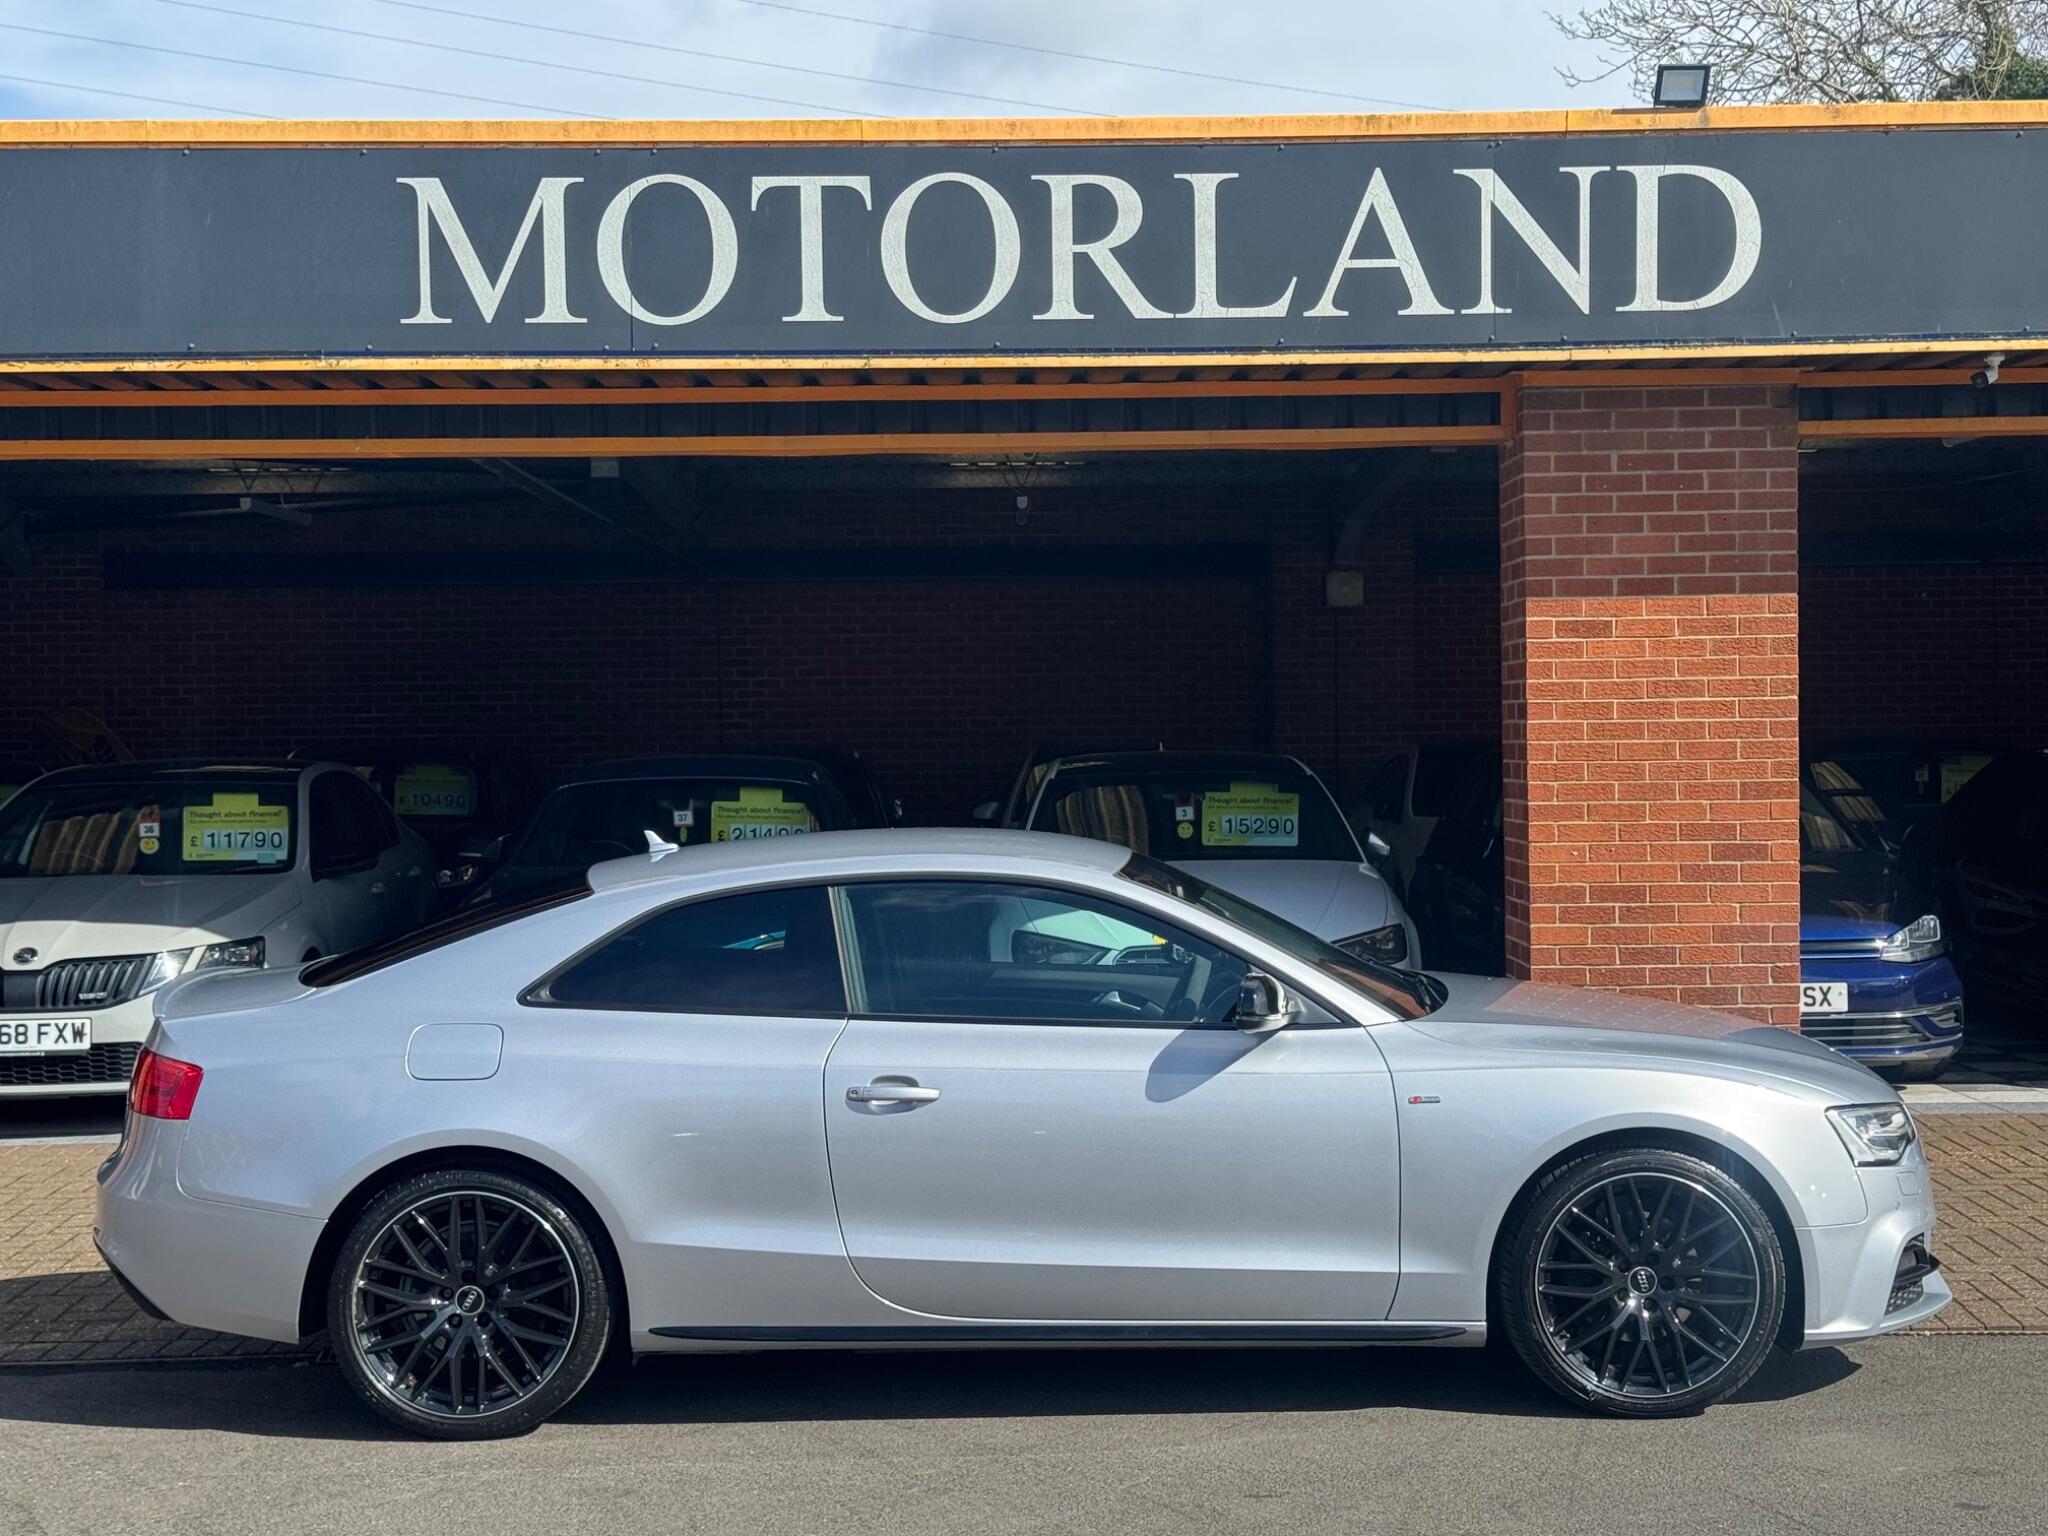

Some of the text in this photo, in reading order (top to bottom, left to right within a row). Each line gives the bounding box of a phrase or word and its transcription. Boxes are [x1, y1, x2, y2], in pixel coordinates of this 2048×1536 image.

[396, 164, 1762, 326] MOTORLAND
[1208, 796, 1237, 804] Thought
[189, 811, 221, 819] Thought
[249, 810, 282, 818] finance?
[717, 806, 747, 814] Thought
[1208, 818, 1295, 834] £ 15290
[190, 831, 282, 848] £ 11790
[718, 830, 725, 841] £
[1803, 986, 1832, 1007] SX
[0, 1022, 86, 1045] 68 FXW
